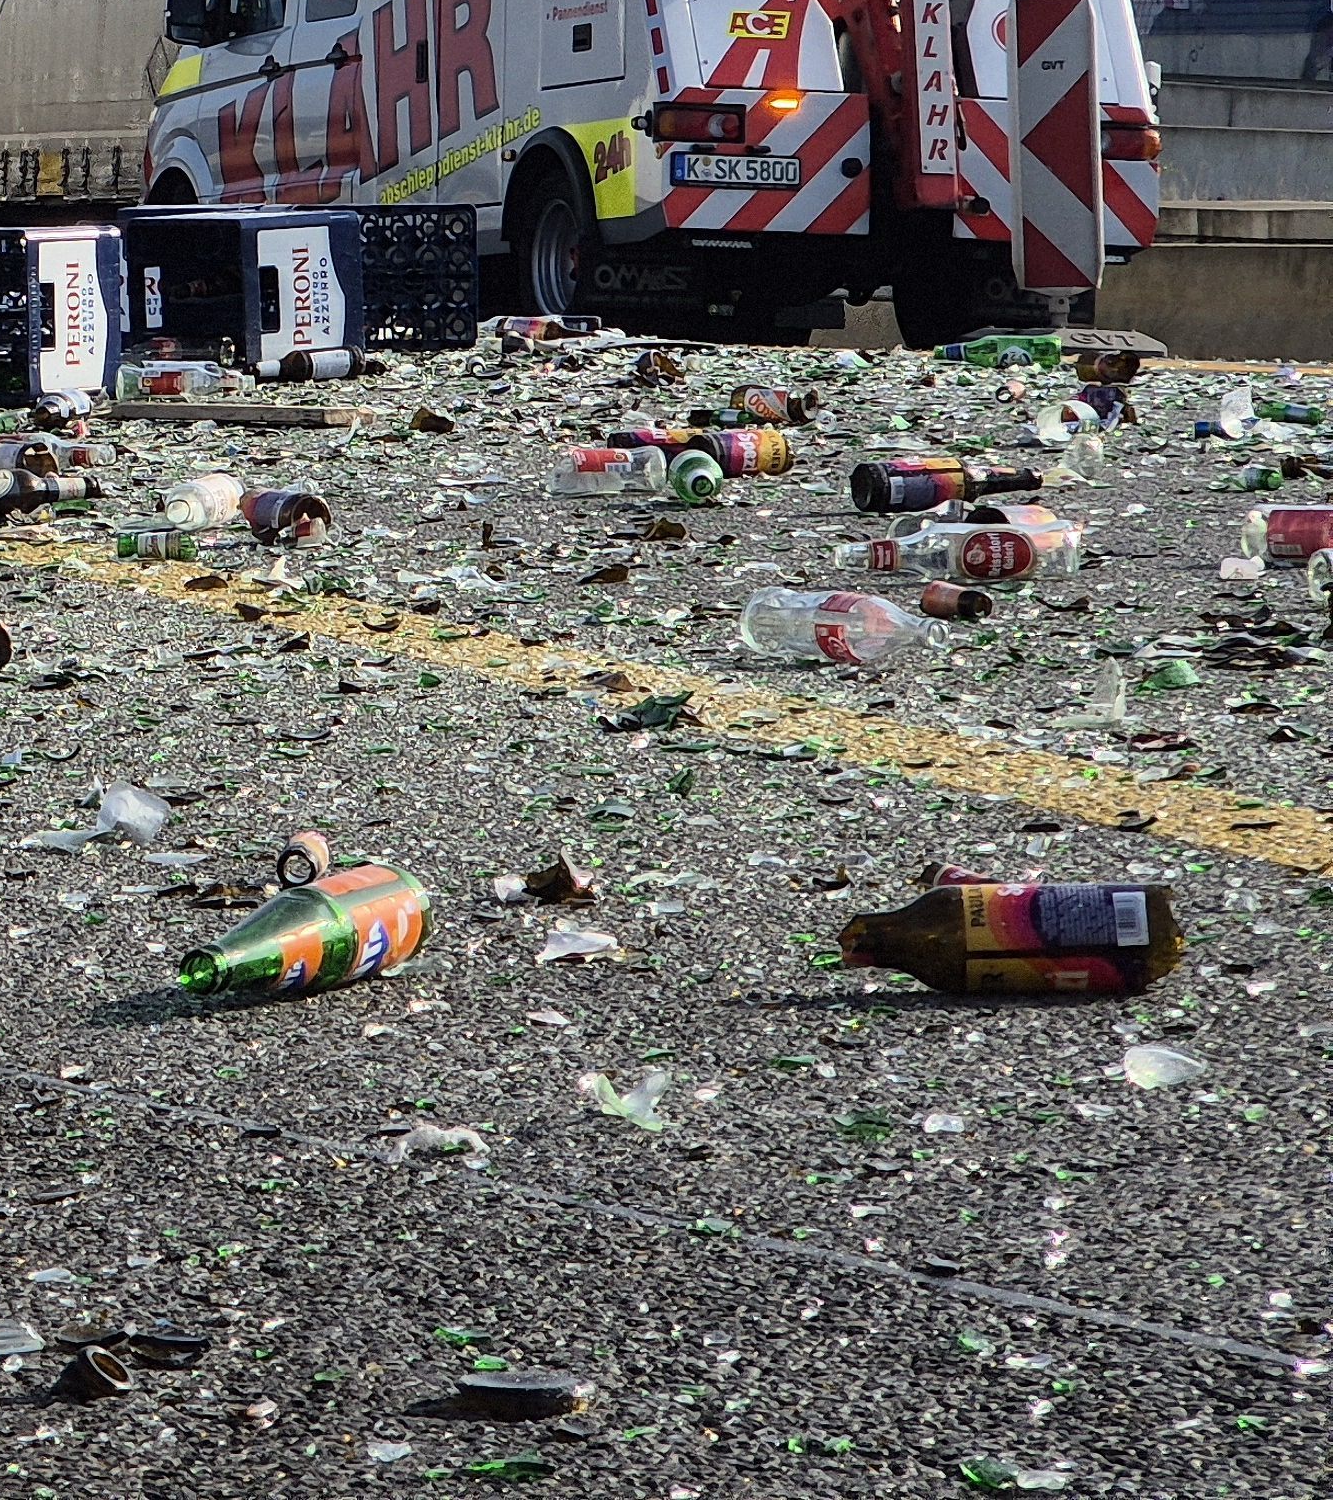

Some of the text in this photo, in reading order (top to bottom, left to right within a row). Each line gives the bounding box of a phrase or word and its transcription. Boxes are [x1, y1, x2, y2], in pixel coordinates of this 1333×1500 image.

[552, 1, 607, 21] Pannendienst
[730, 13, 786, 35] ACE
[922, 3, 949, 161] KLAHR
[1042, 61, 1065, 70] GVT
[595, 131, 631, 184] 24h
[687, 158, 797, 182] K SK 5800
[66, 262, 80, 366] PERONI
[292, 247, 312, 346] PERONI
[320, 257, 330, 335] AZZURRO
[1070, 332, 1135, 346] GVT
